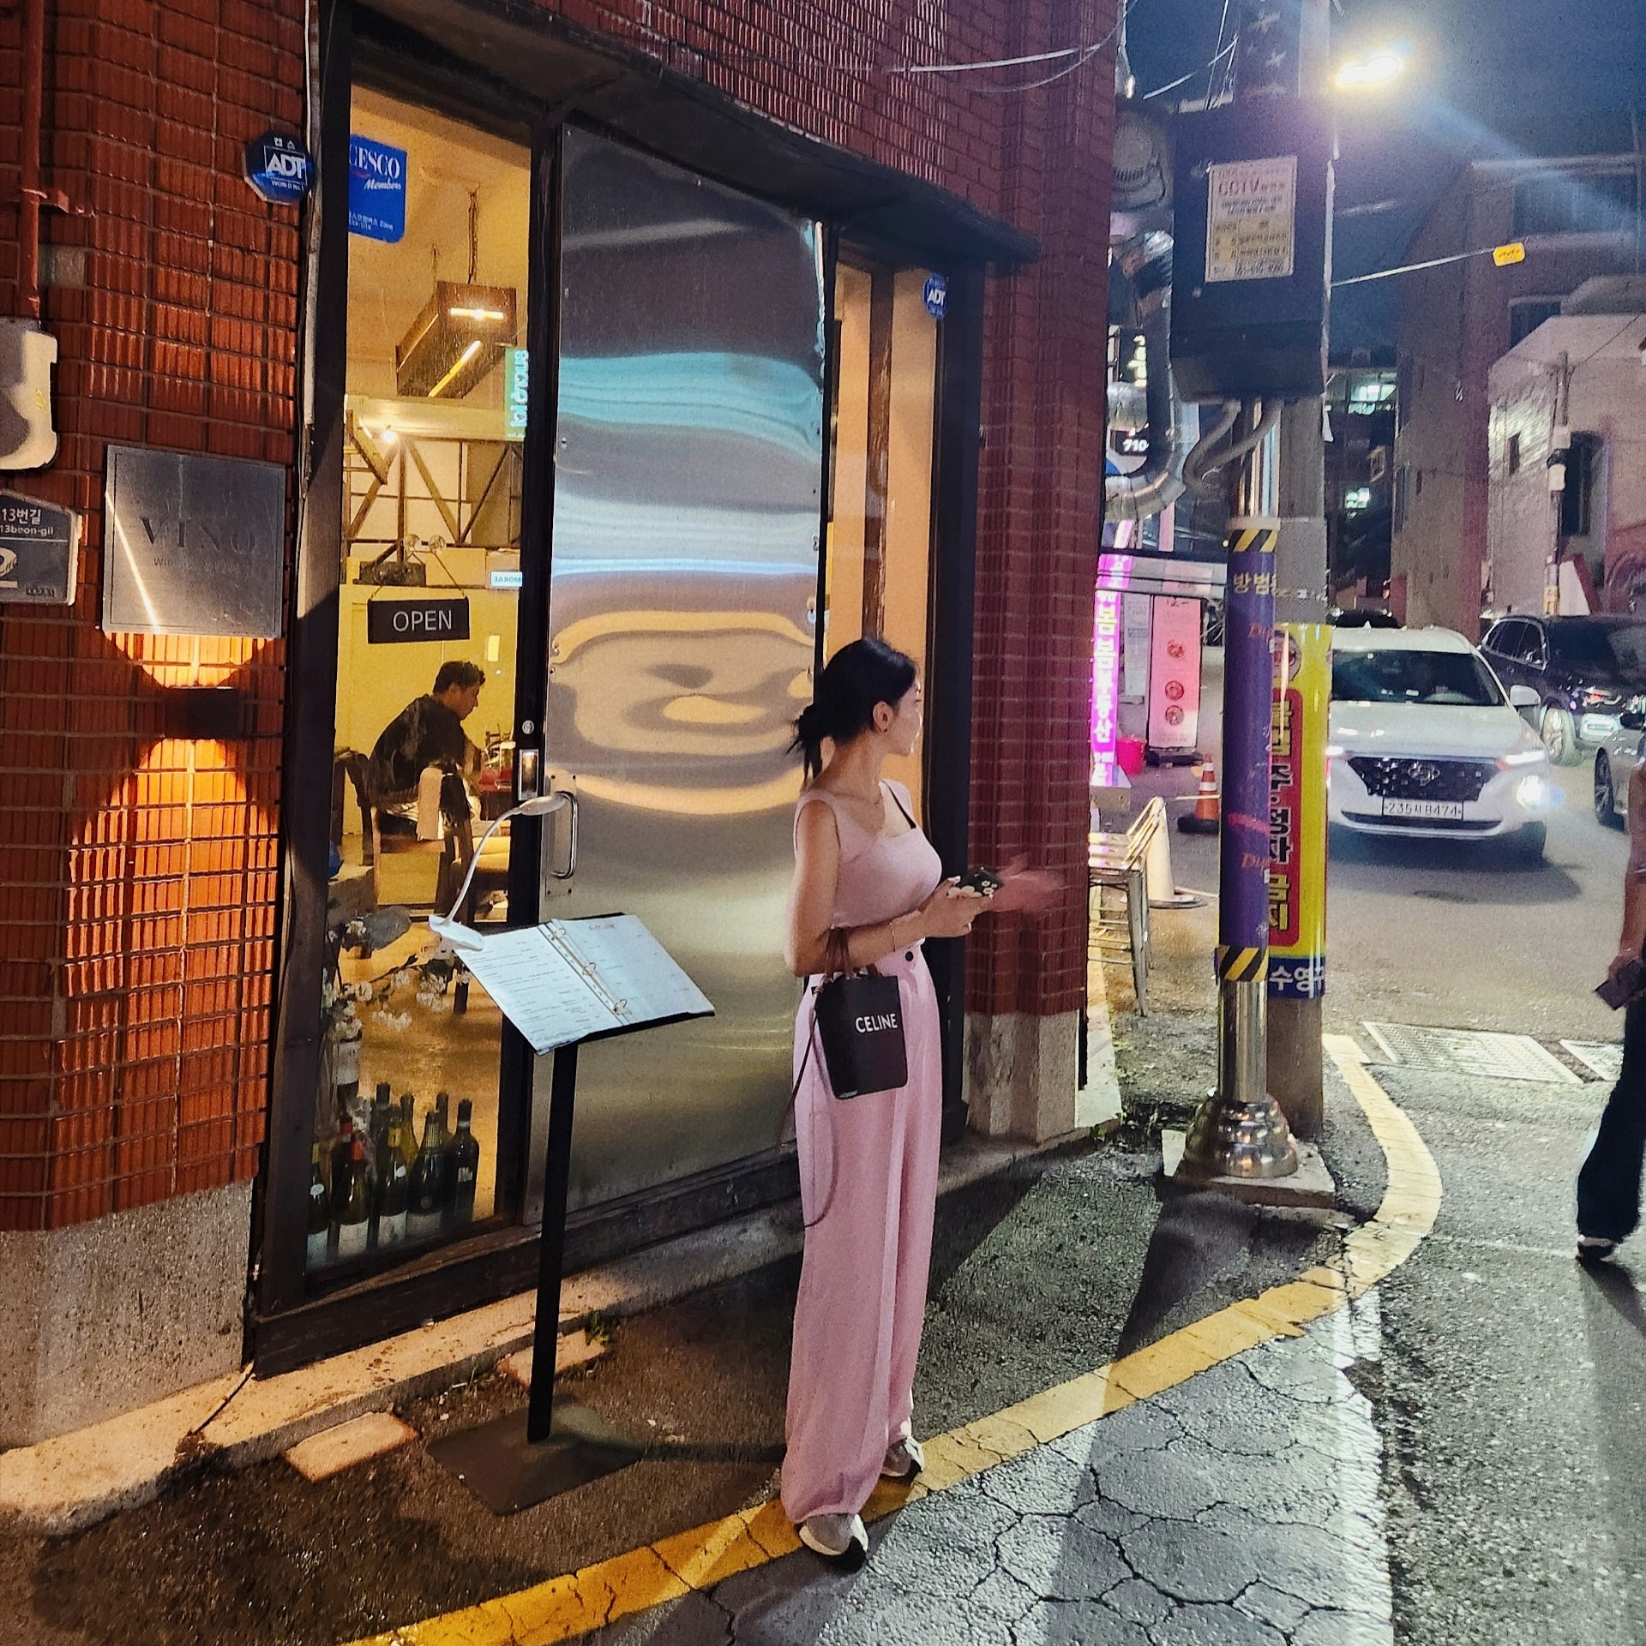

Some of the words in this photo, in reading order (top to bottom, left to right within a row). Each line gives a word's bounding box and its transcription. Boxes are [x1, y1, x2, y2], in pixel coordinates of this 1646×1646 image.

[267, 152, 306, 179] ADT
[348, 143, 400, 179] CESCO
[363, 178, 402, 190] Members
[927, 288, 946, 307] ADT
[140, 515, 256, 555] VINO
[392, 609, 452, 632] OPEN
[855, 1013, 898, 1033] CELINE
